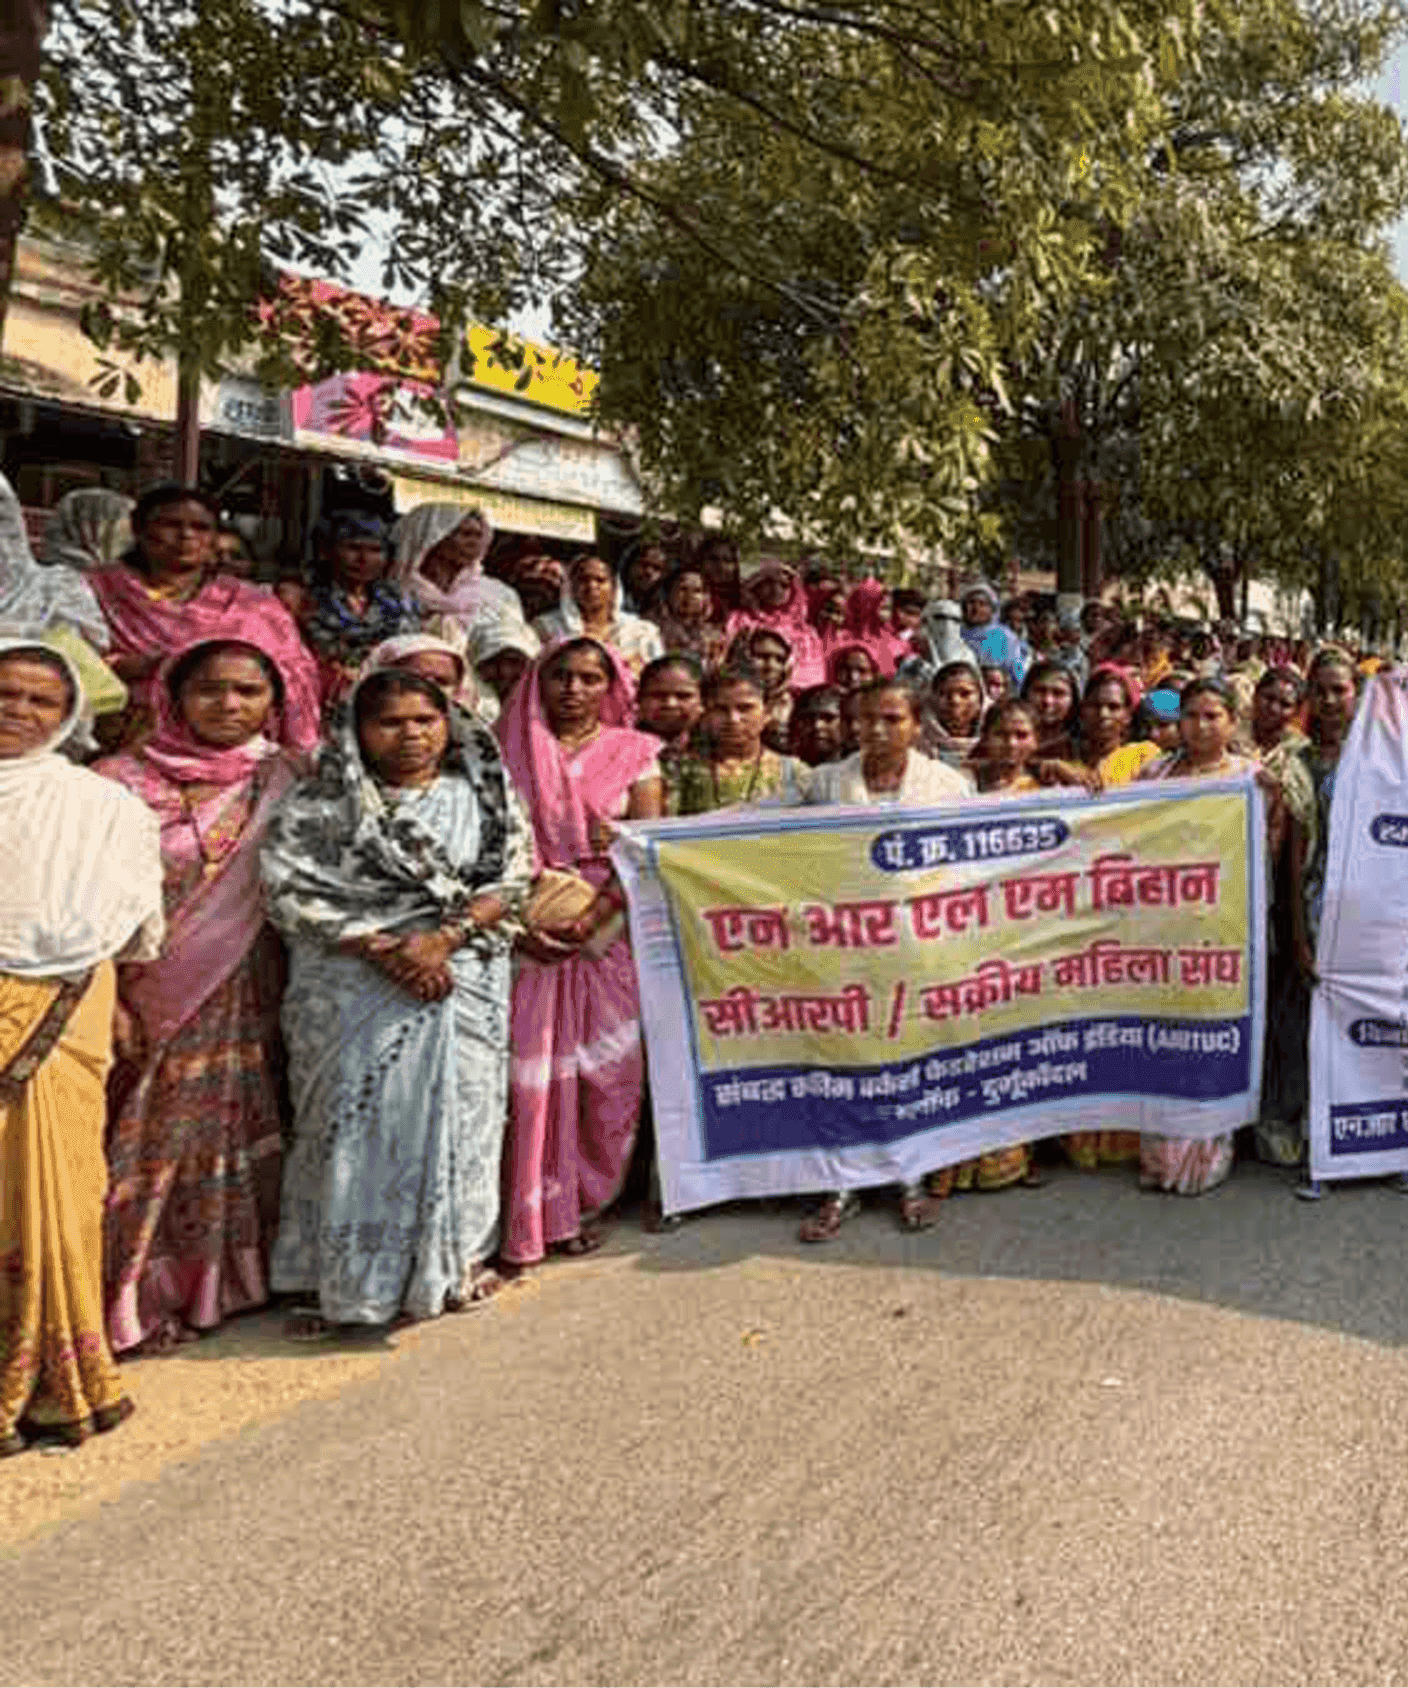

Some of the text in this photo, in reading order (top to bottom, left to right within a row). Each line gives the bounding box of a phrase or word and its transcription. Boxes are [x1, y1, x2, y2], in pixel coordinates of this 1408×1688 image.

[964, 822, 1058, 858] 116635
[704, 854, 1221, 952] एन आर एल एम बिहान
[702, 984, 871, 1039] सीआरपी
[887, 981, 904, 1040] /
[1051, 939, 1170, 989] महिला
[1175, 946, 1241, 988] संघ
